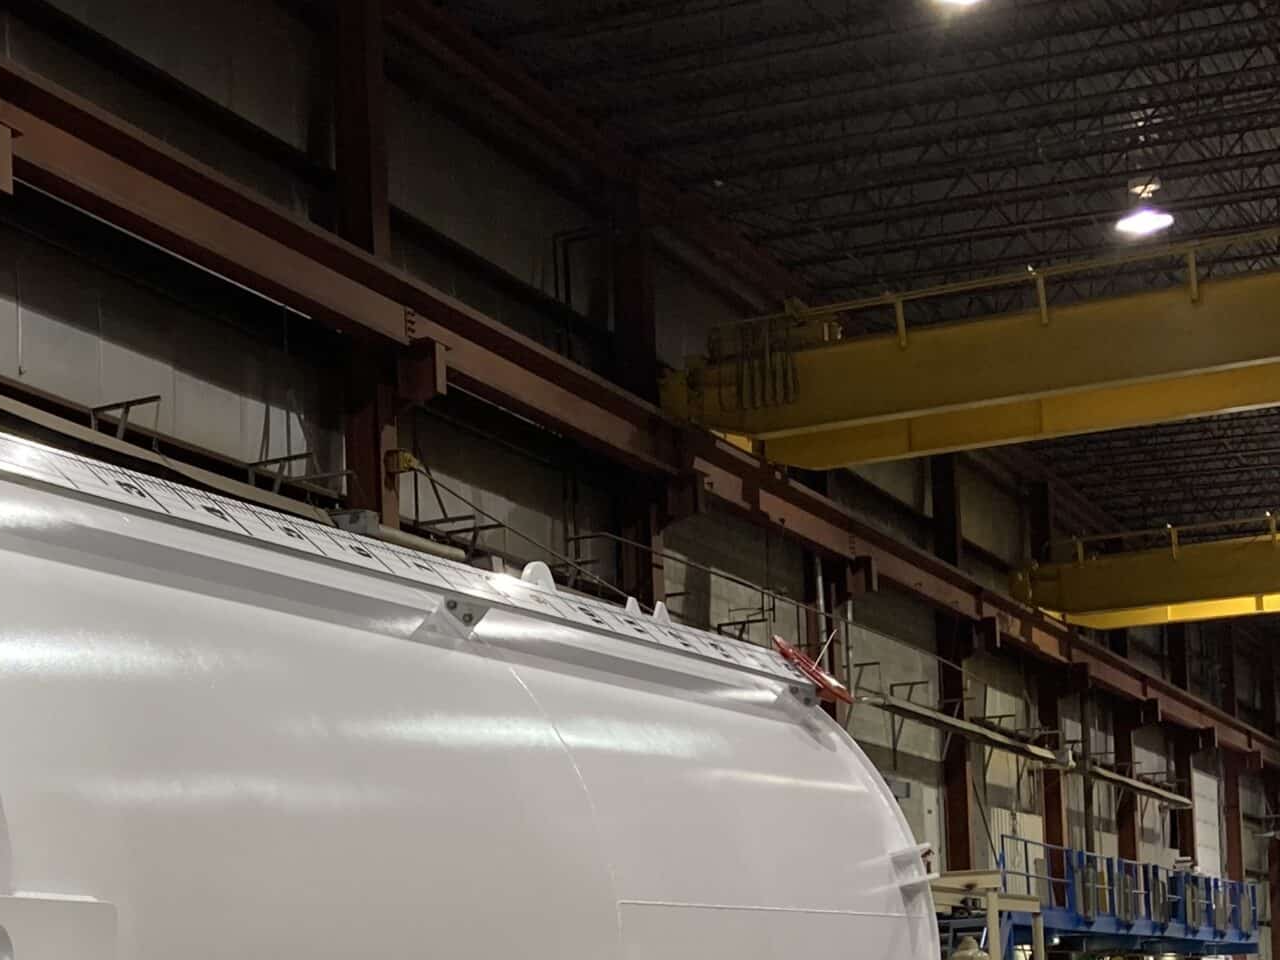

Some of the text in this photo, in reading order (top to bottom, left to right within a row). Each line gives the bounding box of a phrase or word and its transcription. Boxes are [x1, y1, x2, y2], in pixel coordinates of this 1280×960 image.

[115, 480, 147, 498] 3
[200, 504, 230, 522] 4
[349, 544, 373, 559] 6
[576, 605, 605, 625] 10
